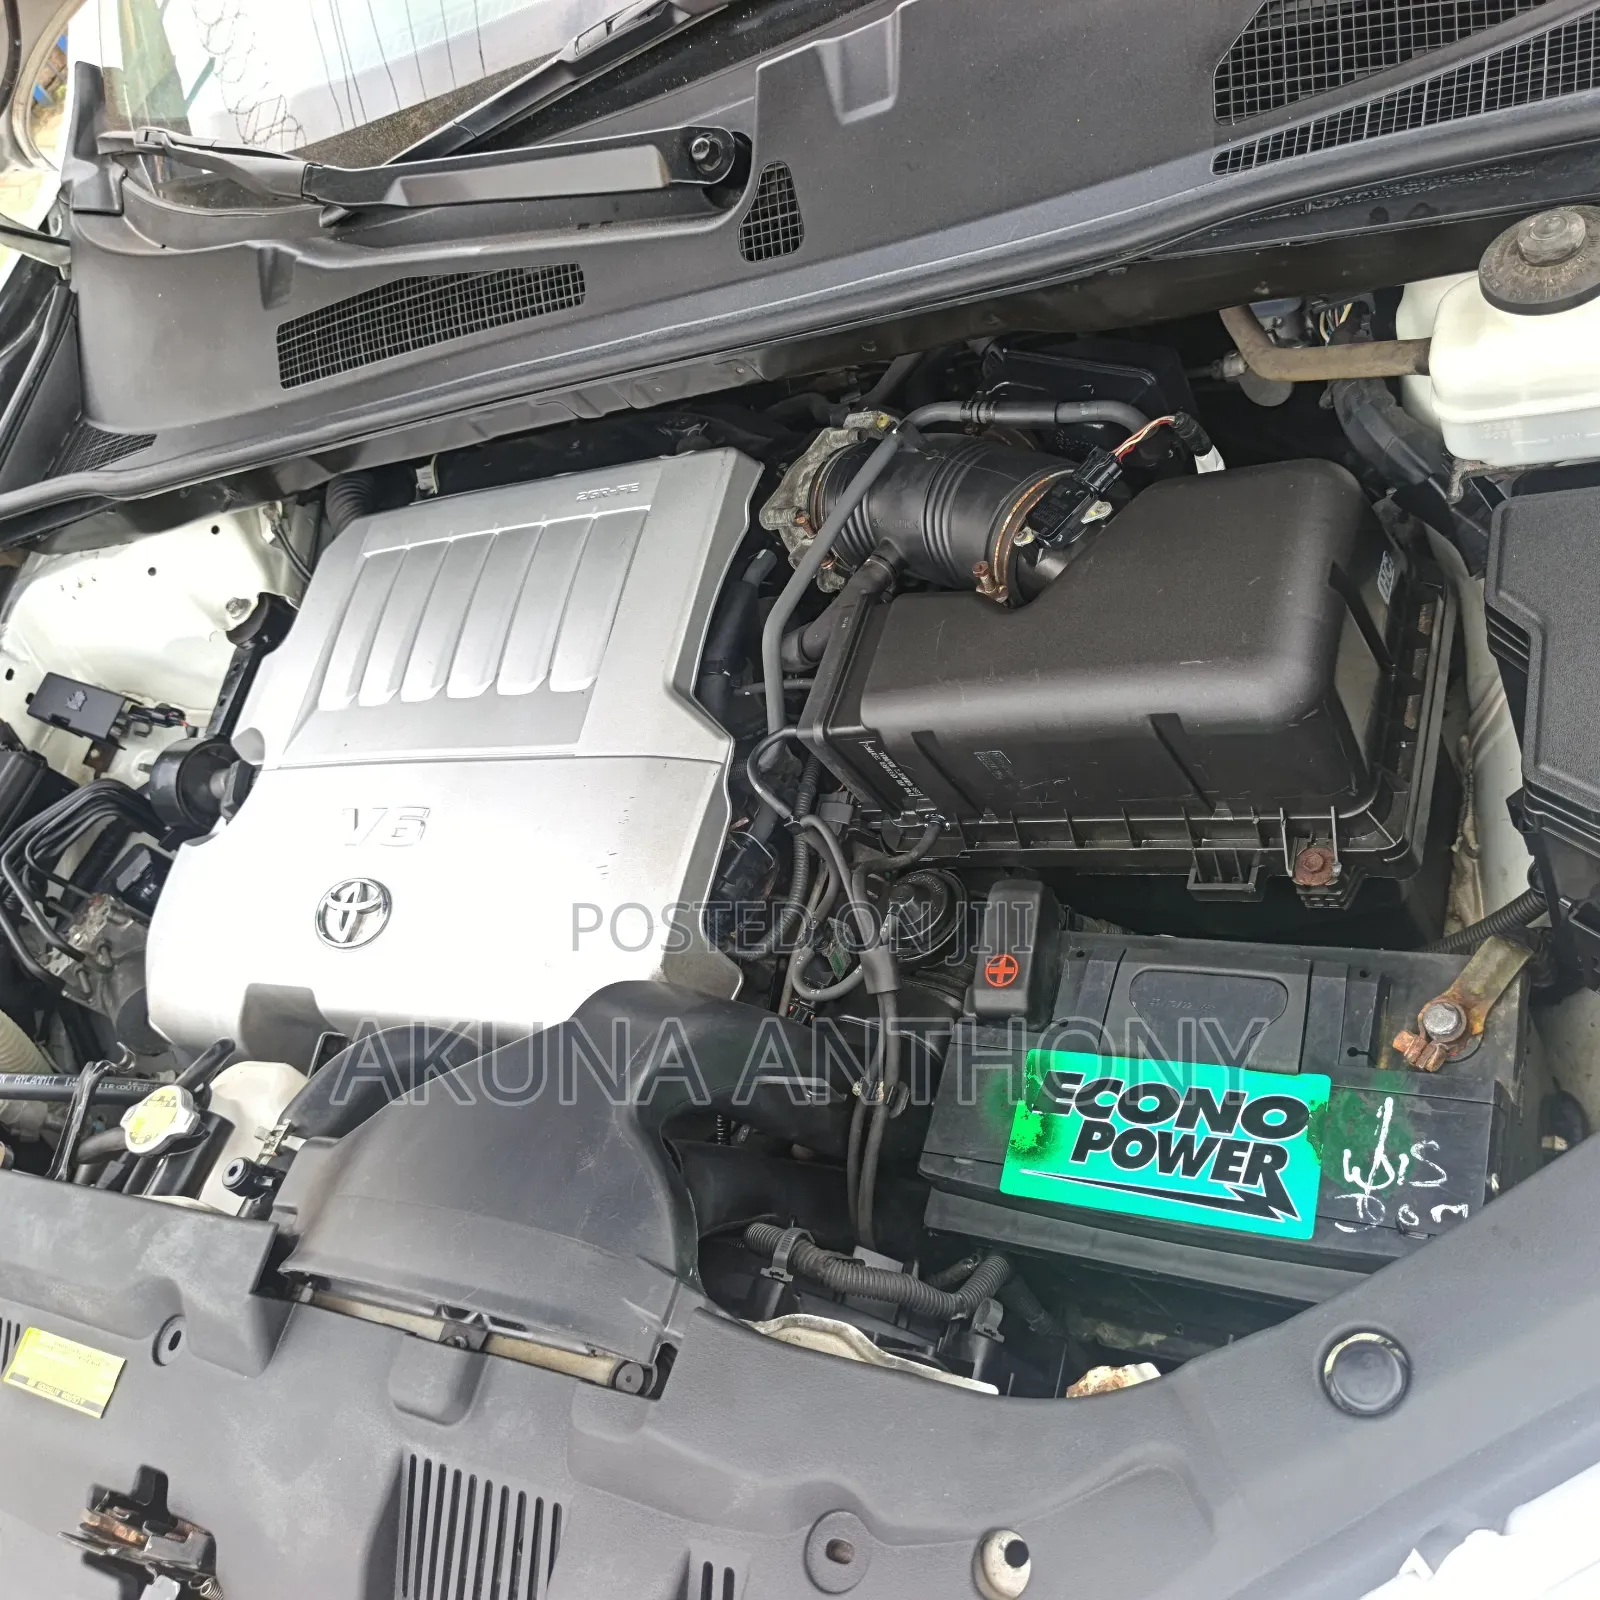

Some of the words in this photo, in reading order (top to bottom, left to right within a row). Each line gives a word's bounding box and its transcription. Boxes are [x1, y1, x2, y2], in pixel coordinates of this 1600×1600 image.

[576, 482, 640, 502] 2GR-FE
[341, 806, 431, 848] V6
[1032, 1070, 1311, 1140] ECONO
[1069, 1118, 1291, 1190] POWER
